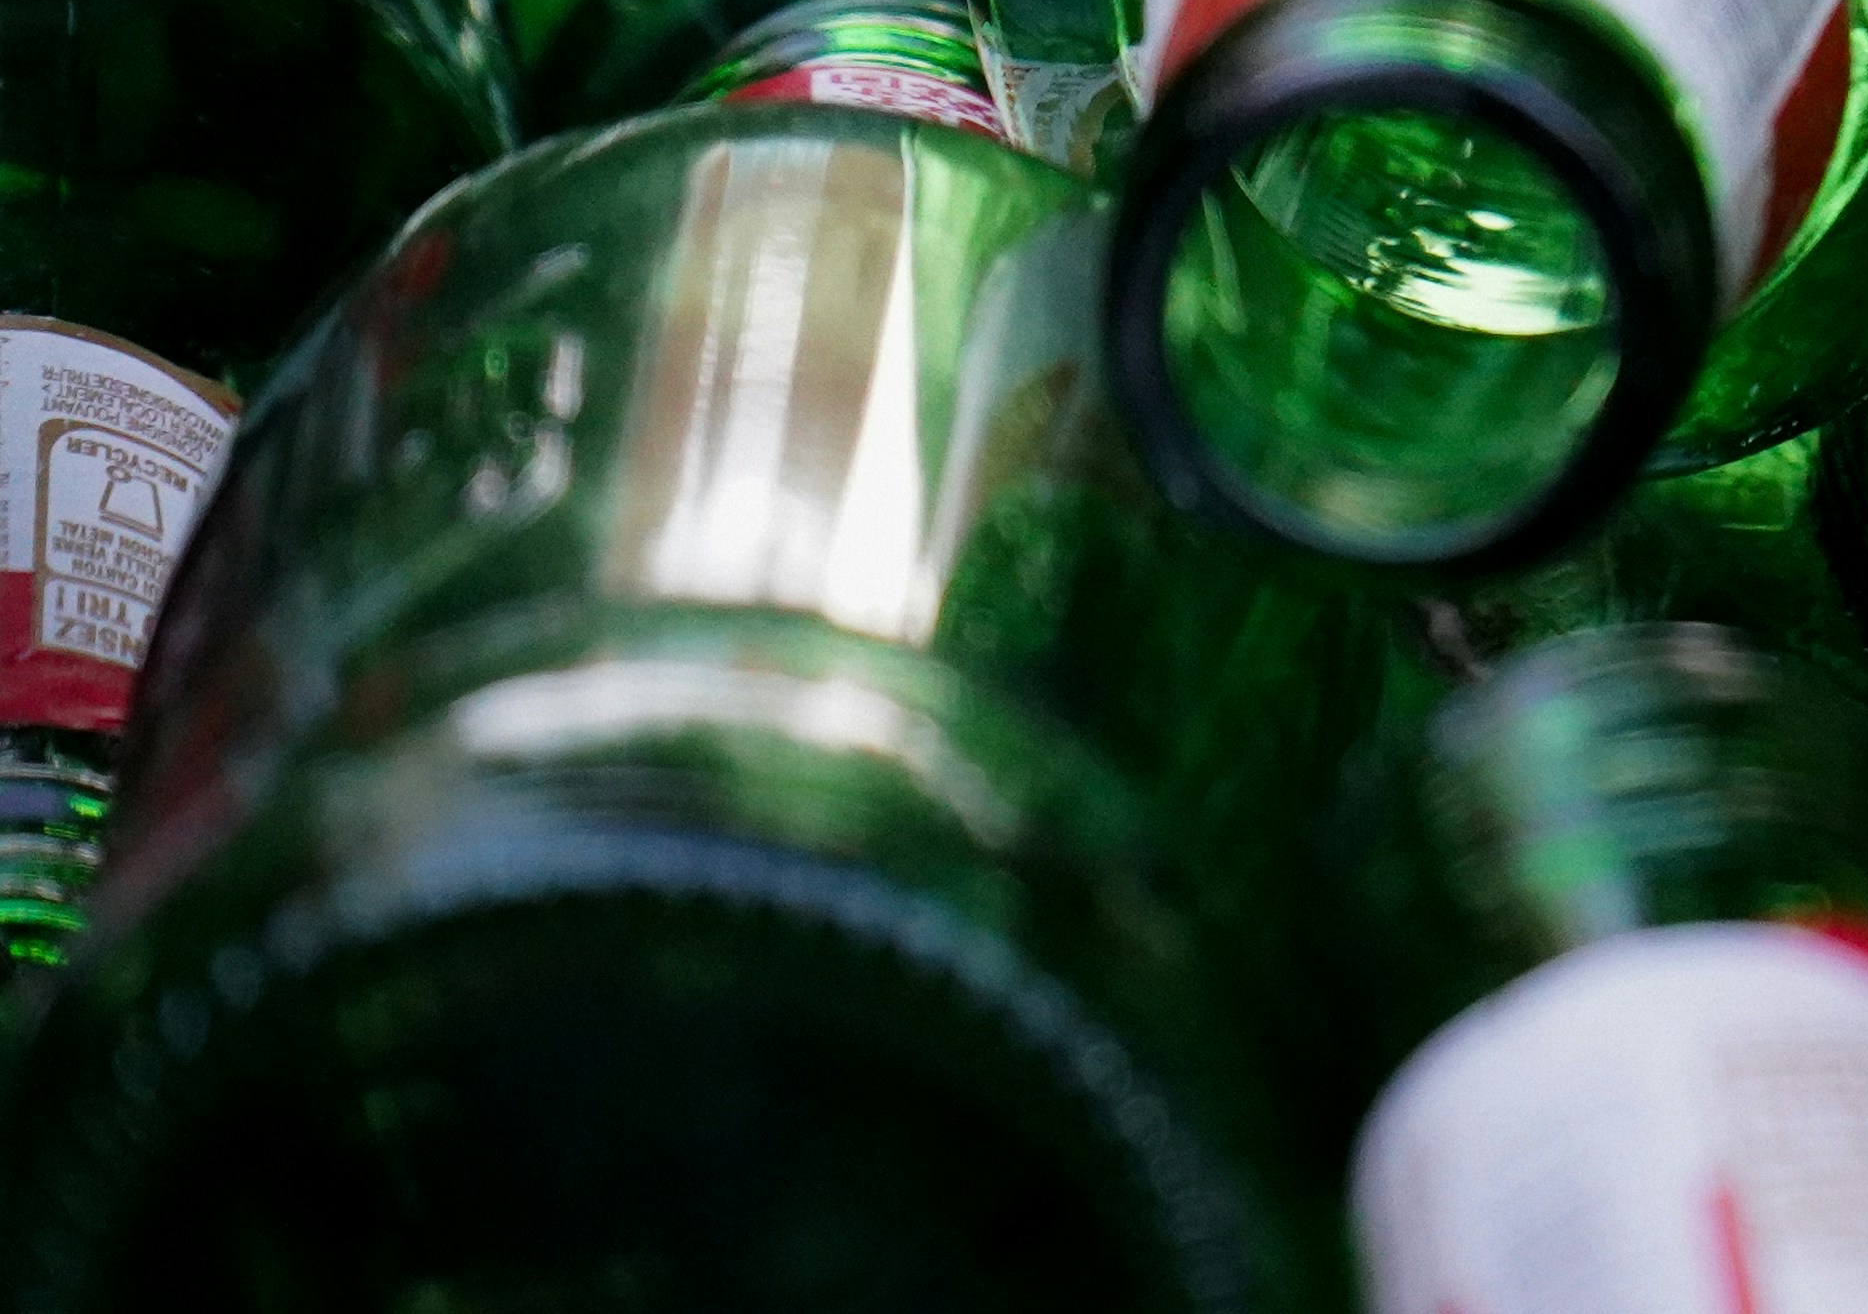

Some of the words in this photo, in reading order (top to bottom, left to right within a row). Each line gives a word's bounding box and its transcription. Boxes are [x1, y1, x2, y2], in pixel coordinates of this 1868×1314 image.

[41, 396, 120, 425] POUVANT
[66, 436, 189, 491] RECYCLER
[77, 589, 131, 631] TRI
